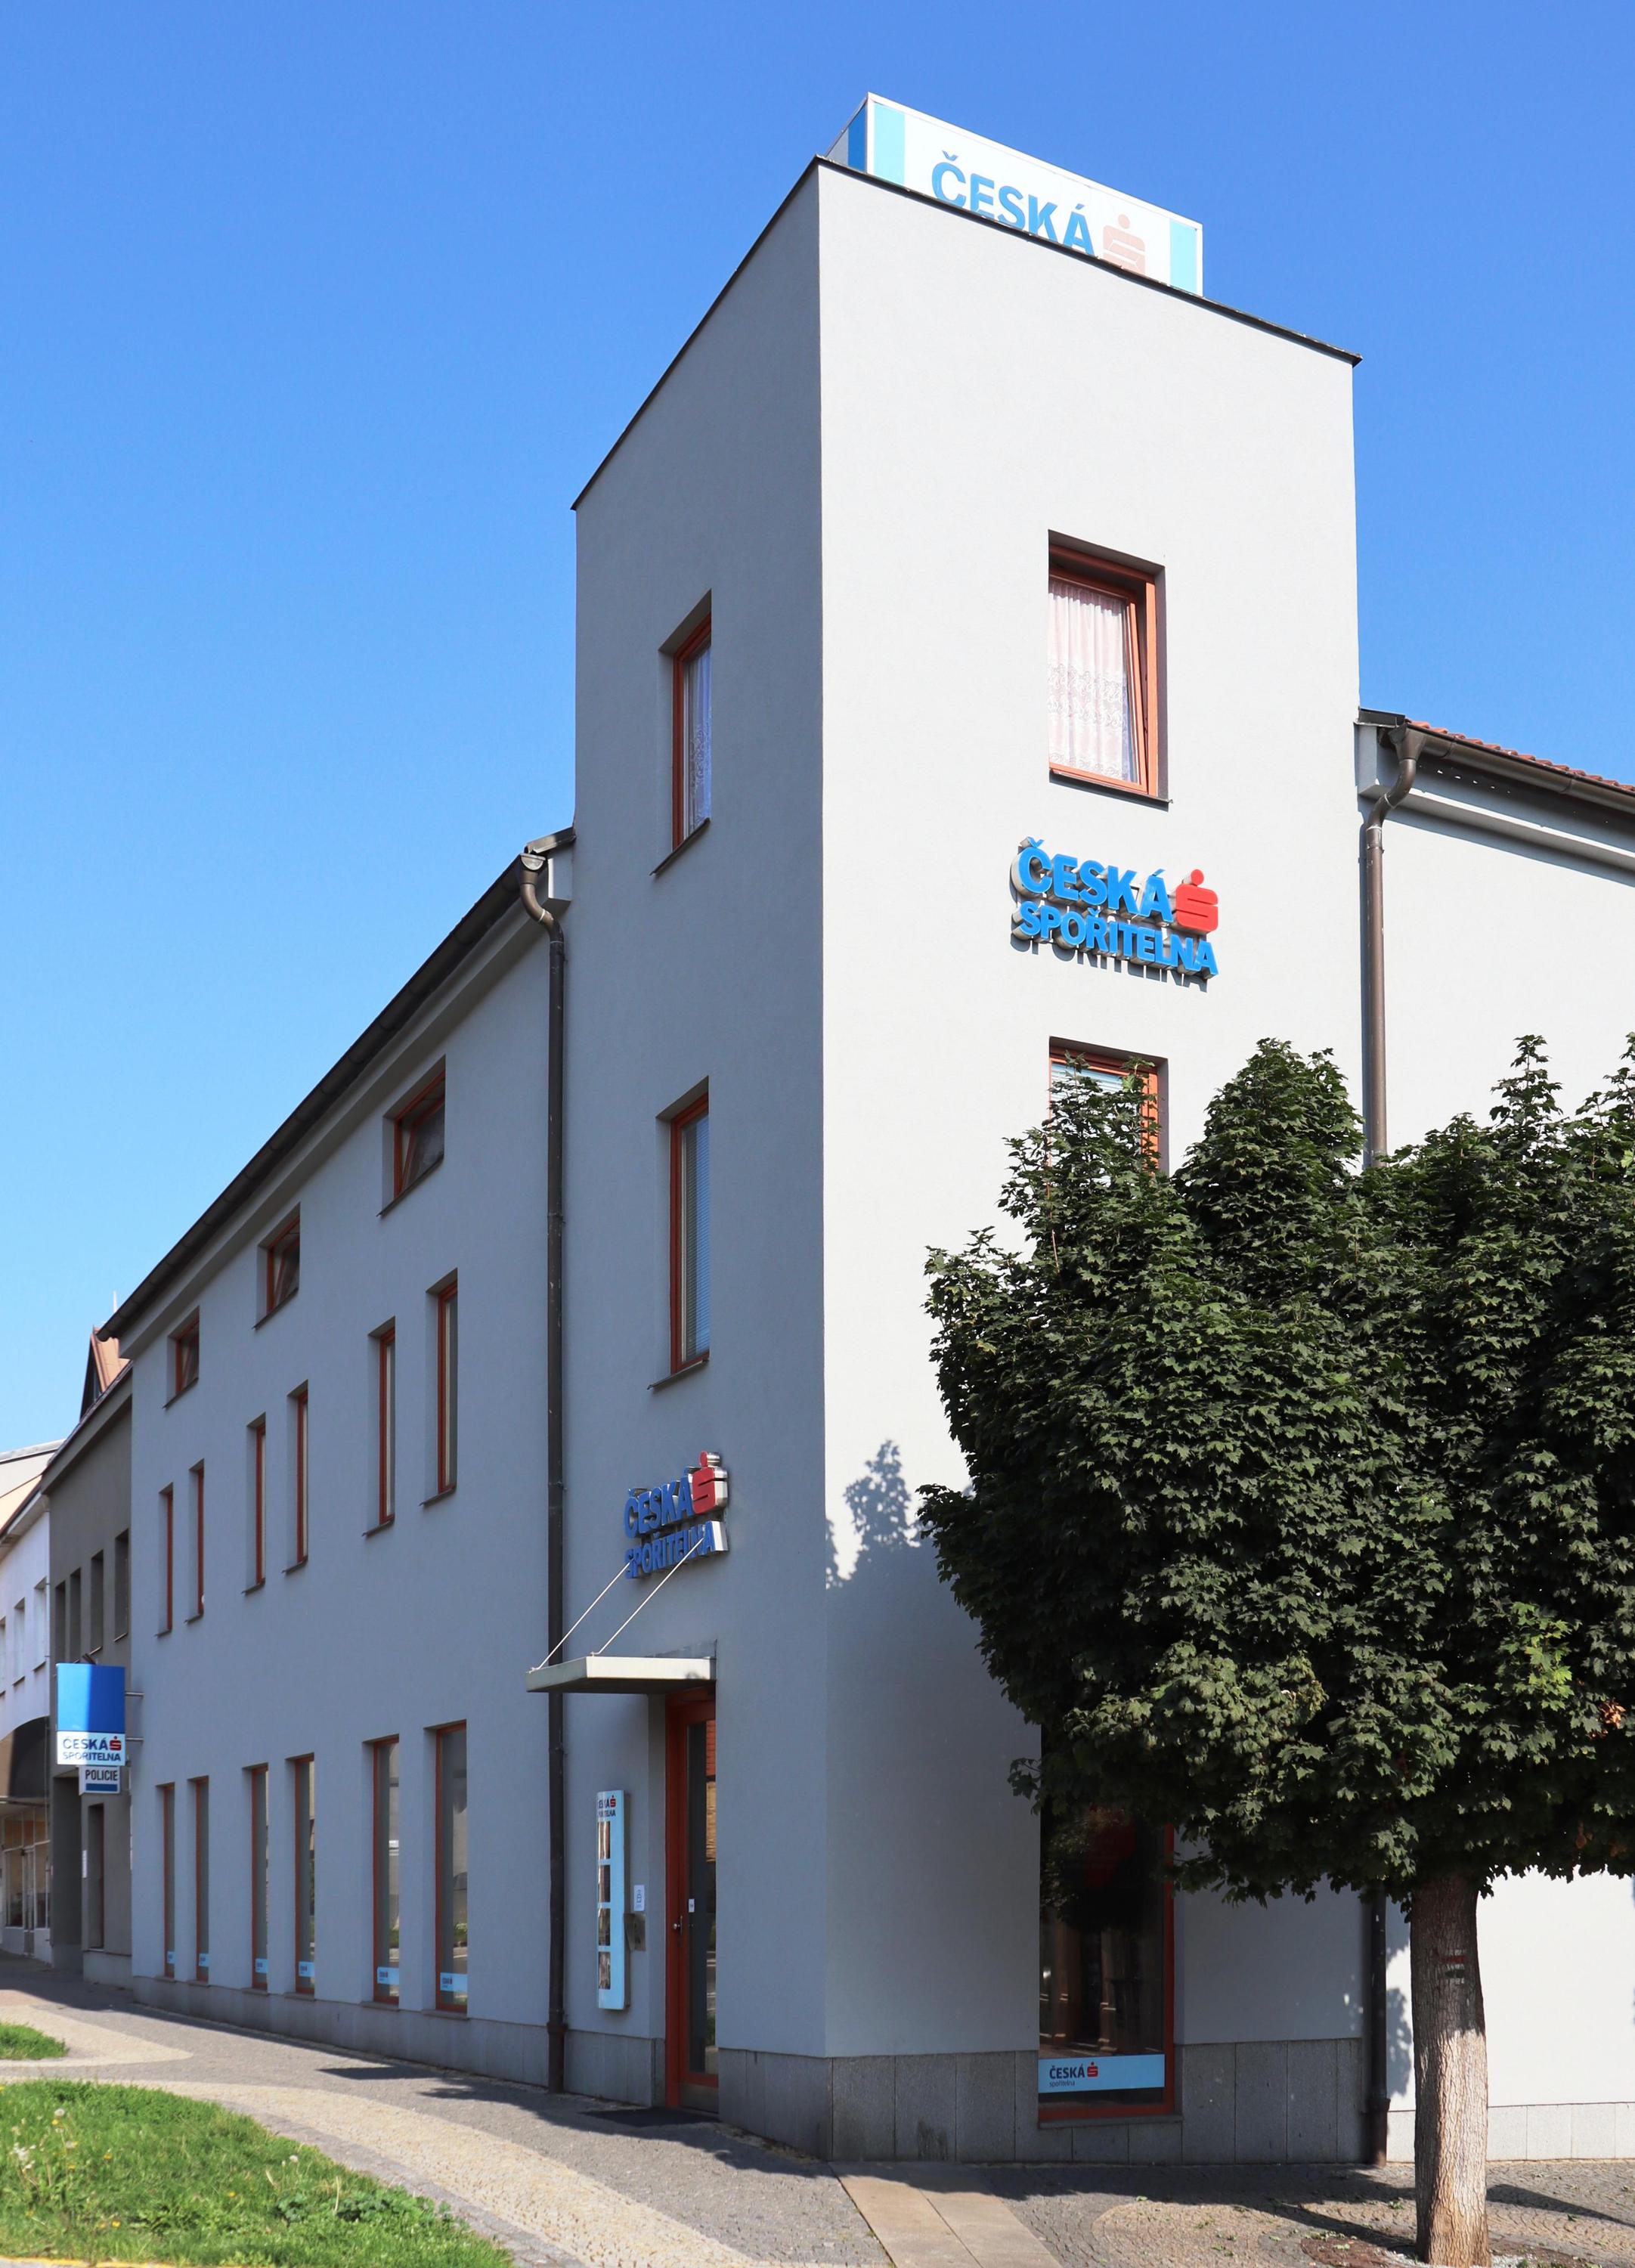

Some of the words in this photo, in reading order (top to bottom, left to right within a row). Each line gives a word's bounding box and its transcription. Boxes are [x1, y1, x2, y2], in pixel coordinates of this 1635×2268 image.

[931, 150, 1097, 257] ČESKÁ
[1014, 837, 1173, 922] ČESKÁ
[1014, 900, 1219, 977] SPOŘITELNA
[624, 1467, 695, 1538] ČESKÁ
[85, 1770, 118, 1781] POLICIE
[1049, 2064, 1085, 2079] ČESKÁ
